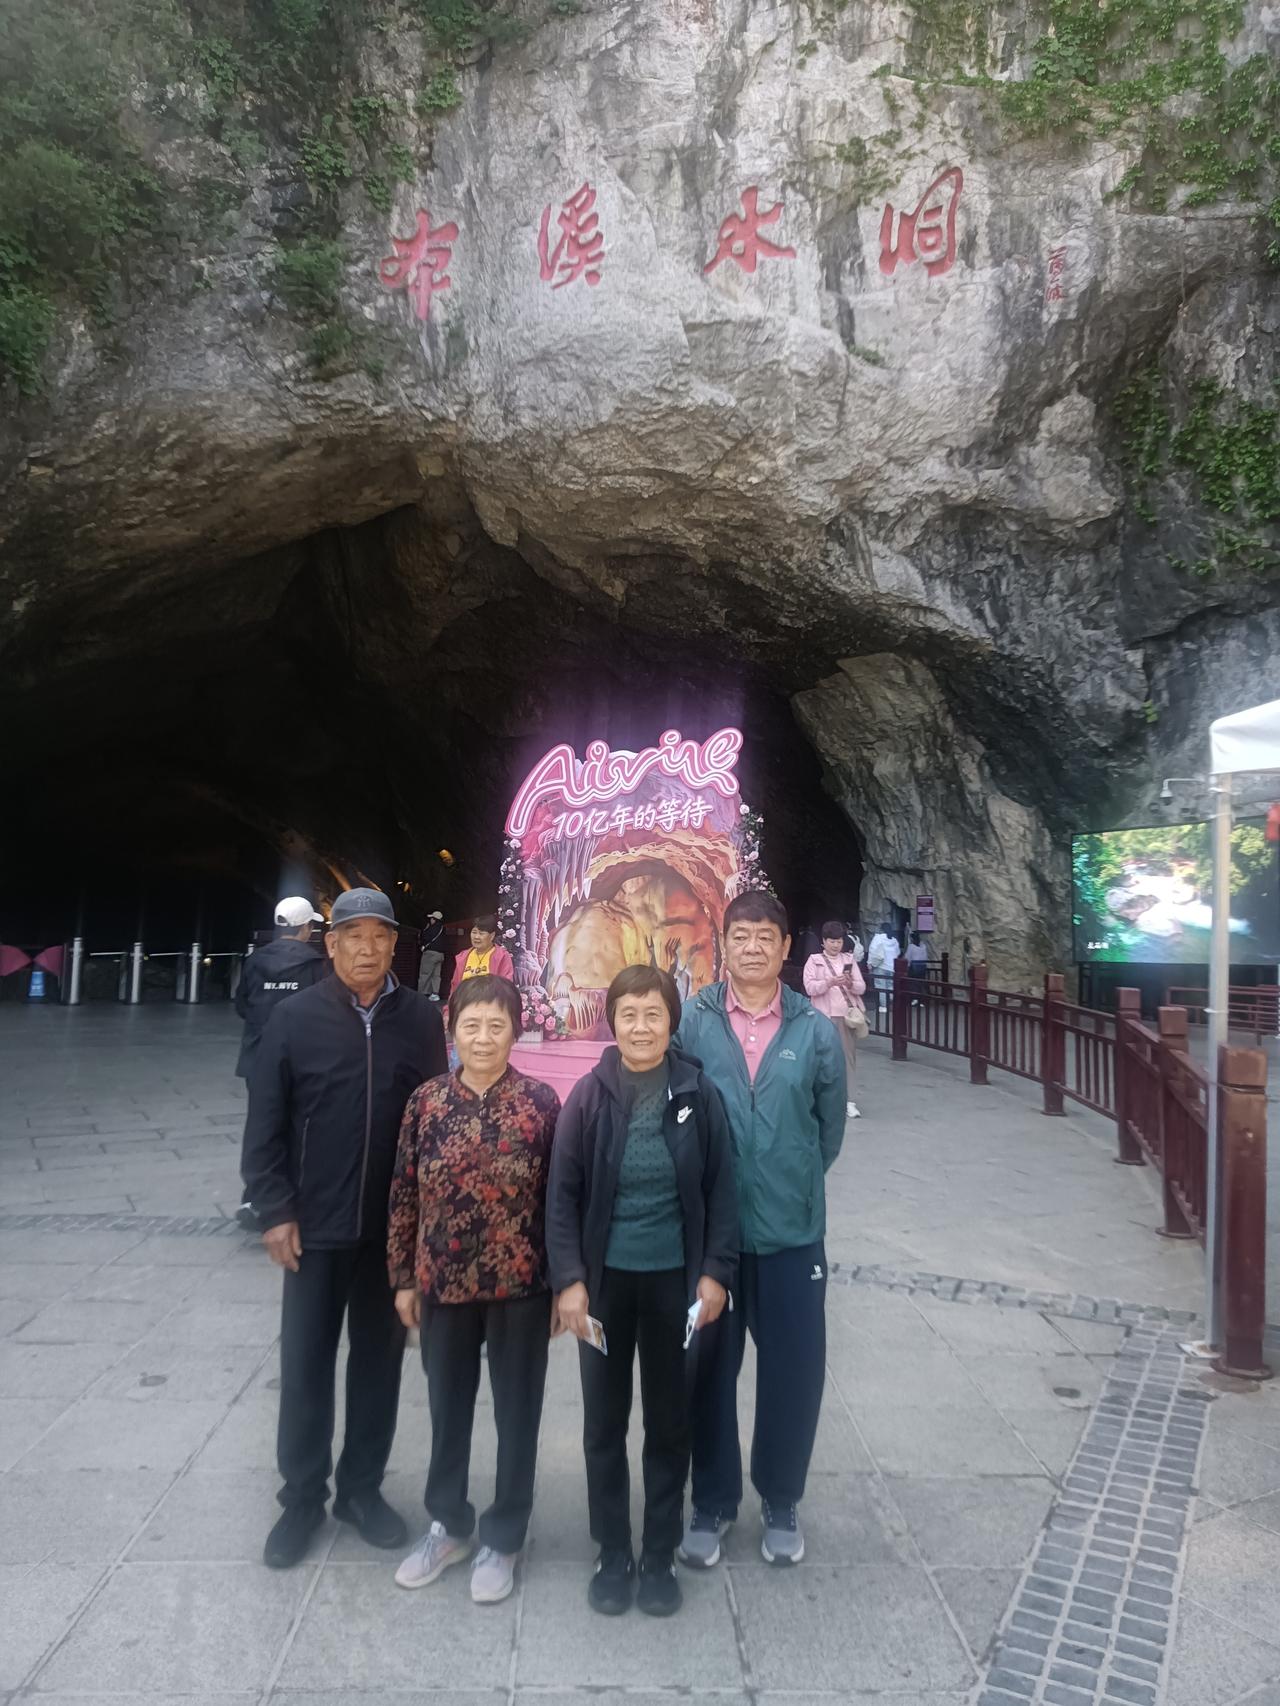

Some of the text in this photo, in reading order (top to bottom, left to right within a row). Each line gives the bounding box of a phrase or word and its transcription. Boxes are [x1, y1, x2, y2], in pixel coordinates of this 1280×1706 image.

[380, 166, 963, 321] 本溪水洞
[551, 795, 714, 842] 10亿年的等待
